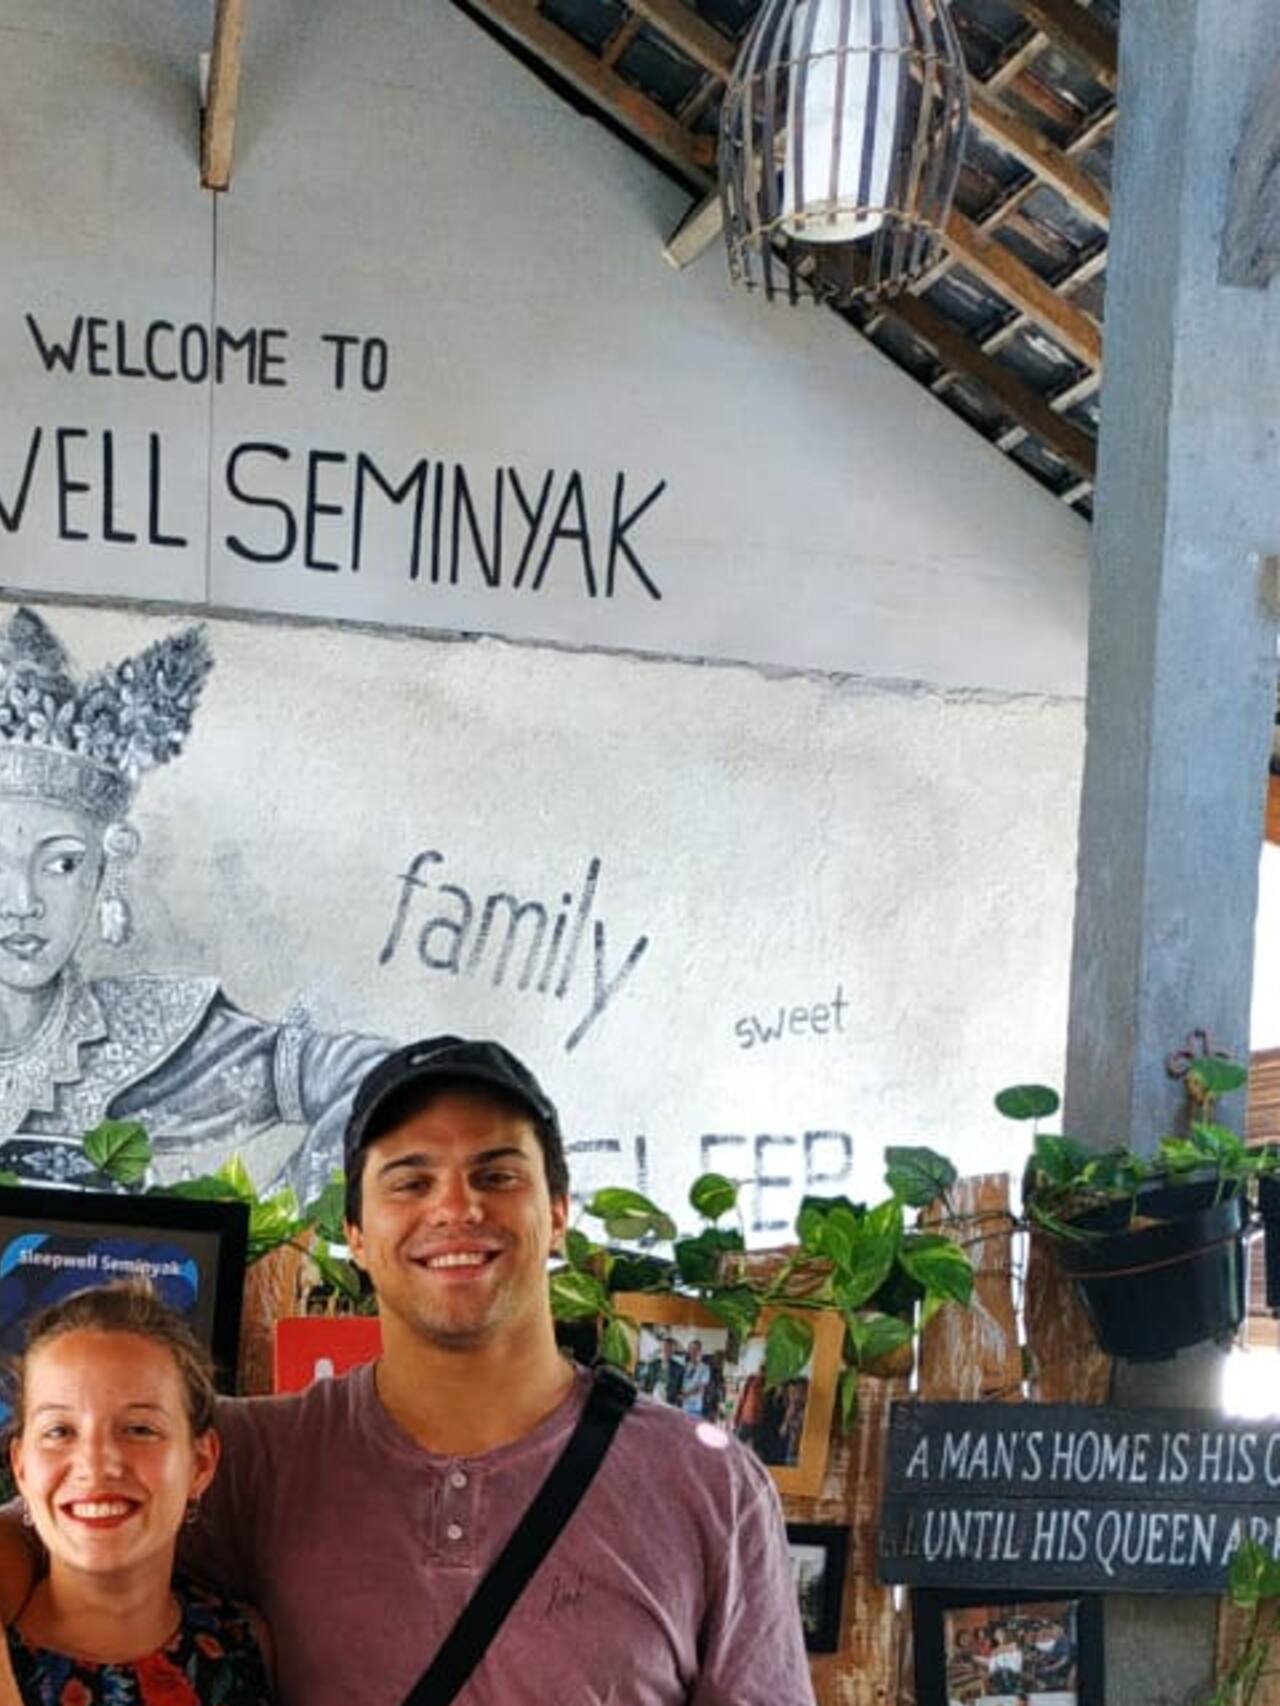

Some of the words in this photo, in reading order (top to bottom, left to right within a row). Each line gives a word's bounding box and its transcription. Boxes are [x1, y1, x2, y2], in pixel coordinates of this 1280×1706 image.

[25, 313, 287, 387] WELCOME
[322, 335, 389, 391] TO
[224, 442, 667, 600] SEMINYAK
[379, 849, 650, 1053] family
[734, 985, 850, 1050] sweet
[17, 1249, 98, 1271] Sleepwell
[905, 1437, 930, 1480] A
[939, 1430, 1044, 1482] MAN'S
[1049, 1430, 1150, 1484] HOME
[1158, 1432, 1191, 1484] IS
[1198, 1432, 1257, 1484] HIS
[923, 1510, 1020, 1562] UNTIL
[1029, 1510, 1093, 1563] HIS
[1095, 1509, 1218, 1577] QUEEN
